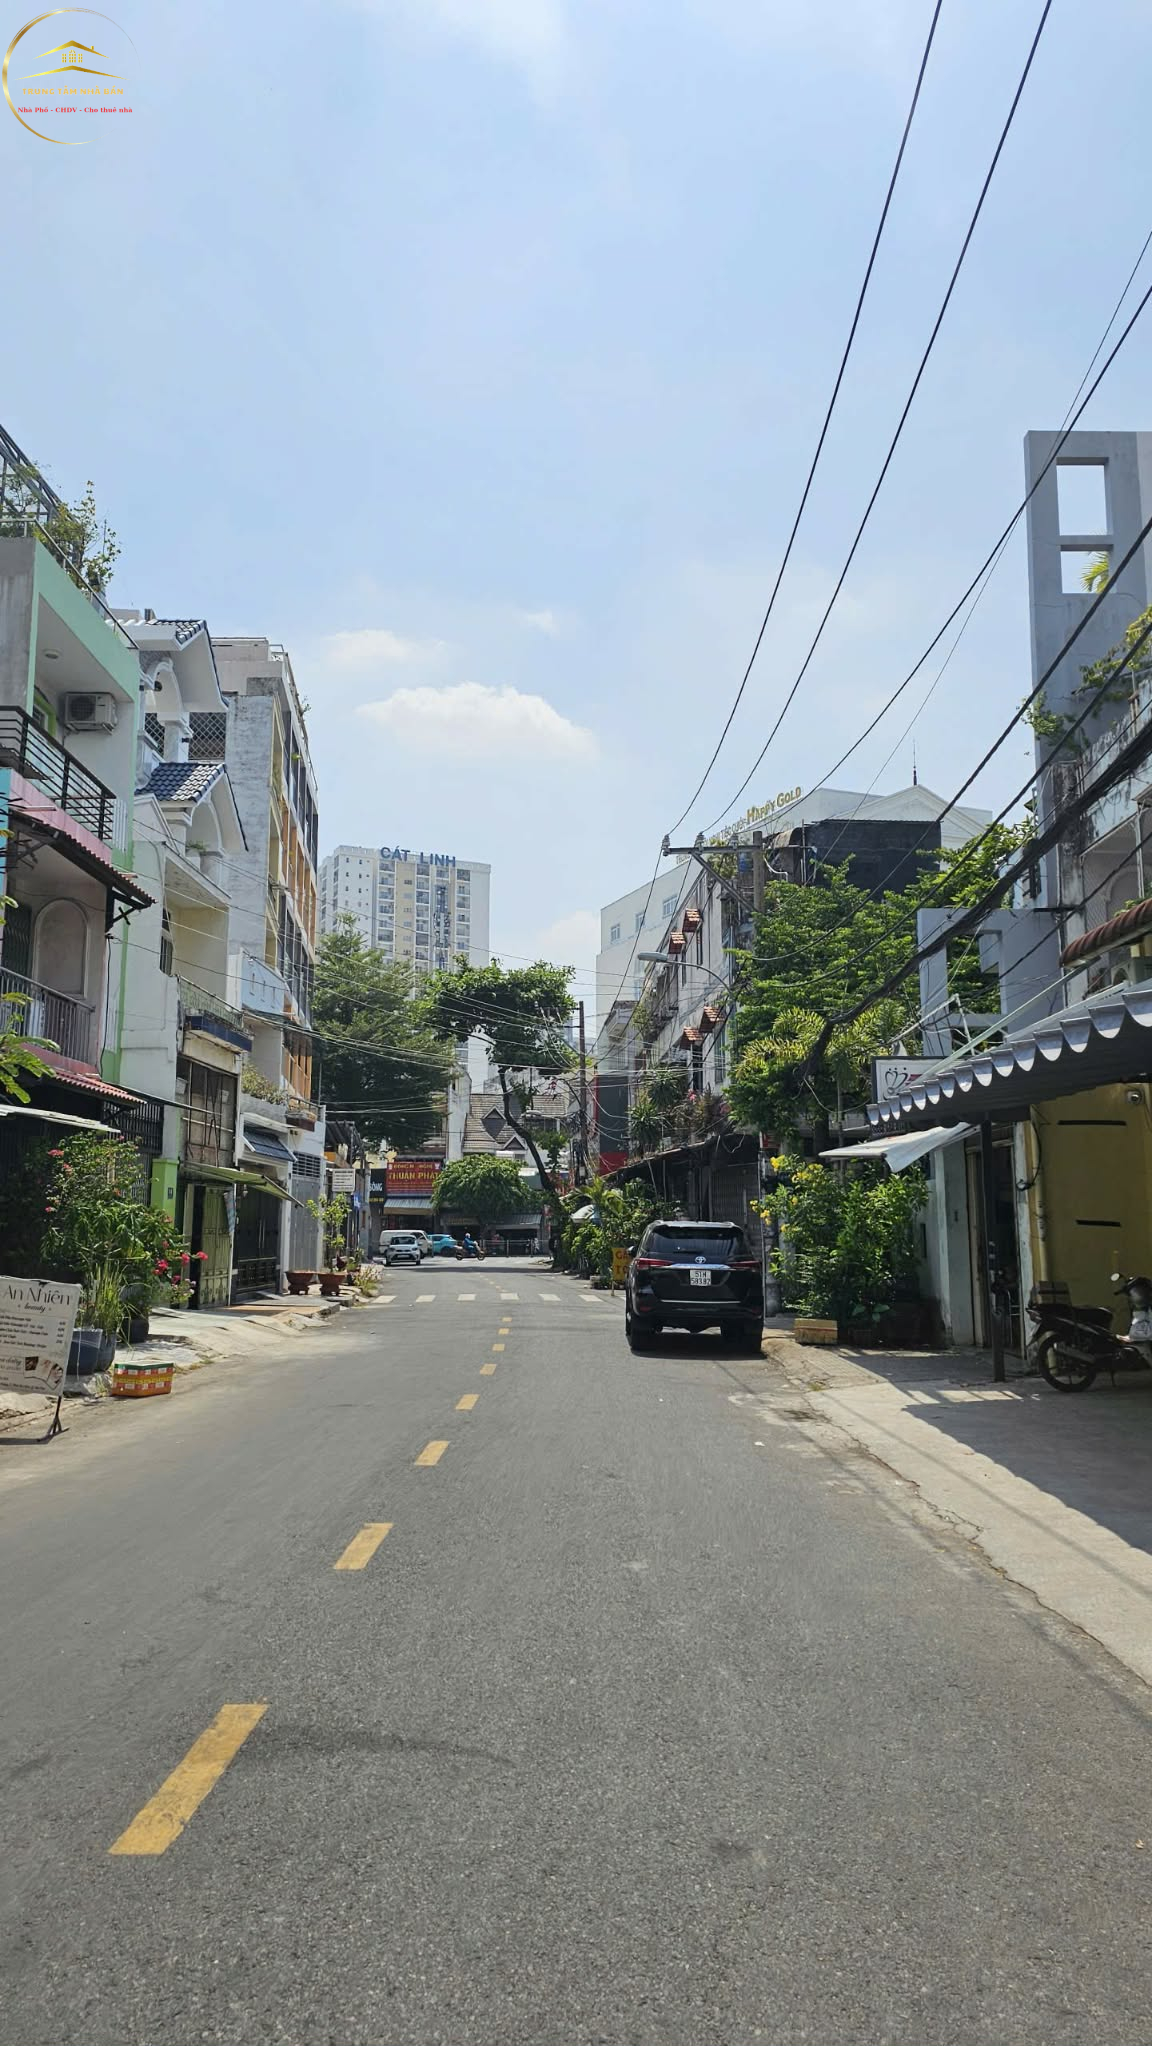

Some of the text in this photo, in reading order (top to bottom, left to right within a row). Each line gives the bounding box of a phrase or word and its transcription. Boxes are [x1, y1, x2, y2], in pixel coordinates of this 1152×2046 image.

[747, 801, 776, 823] HAPPY
[776, 787, 801, 807] GOLD
[380, 845, 456, 867] CÁT LINH
[3, 1284, 71, 1305] An Nhiên
